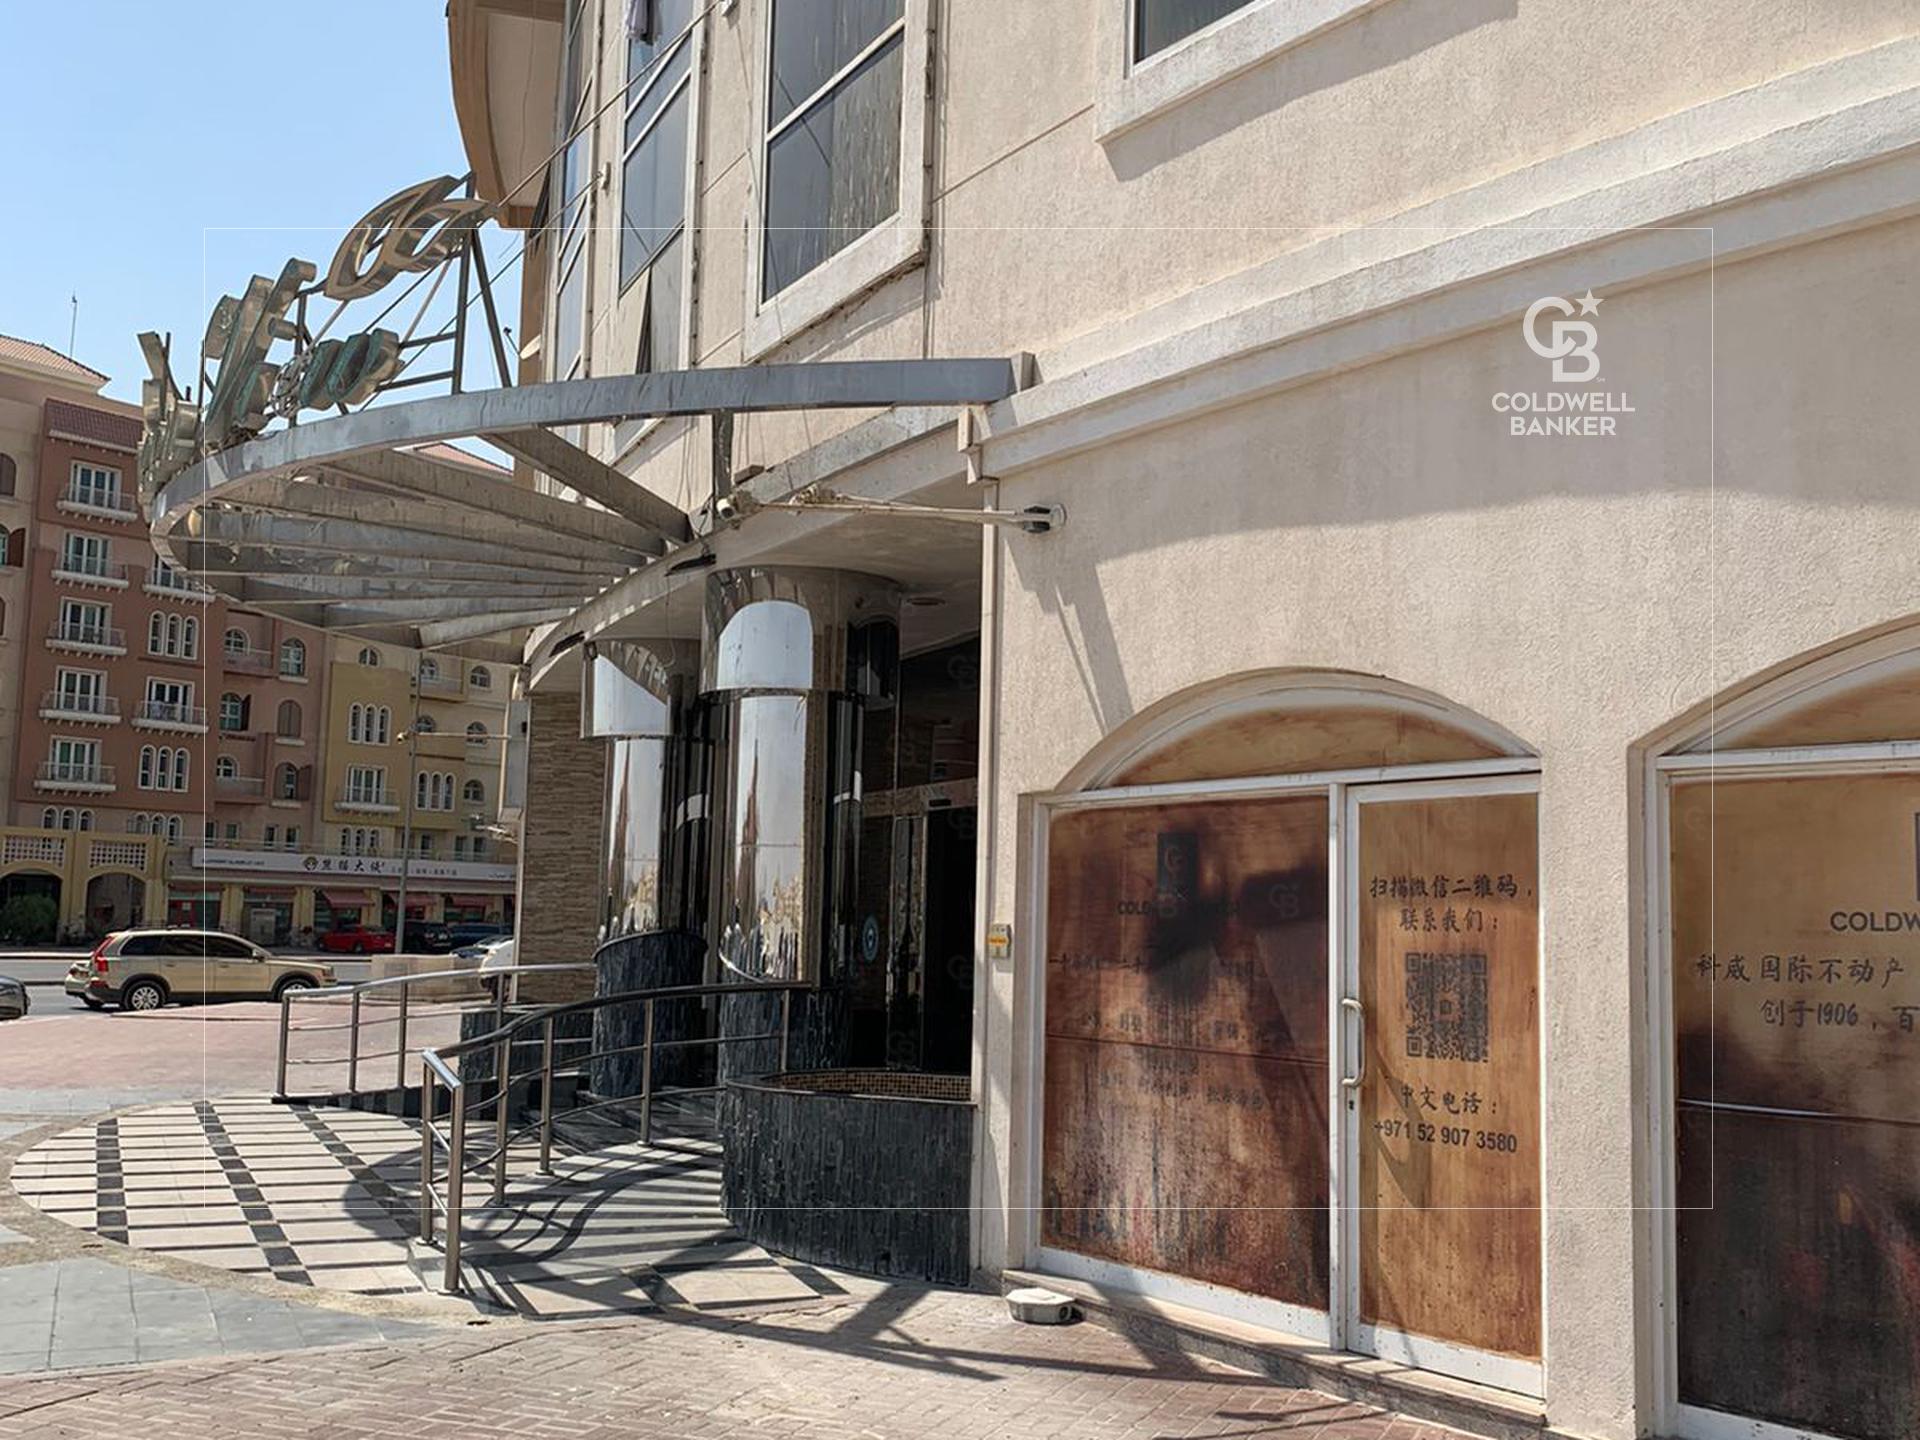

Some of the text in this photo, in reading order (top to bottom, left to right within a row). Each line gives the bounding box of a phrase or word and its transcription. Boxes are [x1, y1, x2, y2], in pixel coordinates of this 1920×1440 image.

[1696, 953, 1904, 989] 科威国际不动产
[1374, 1119, 1517, 1154] +971 52 907 3580
